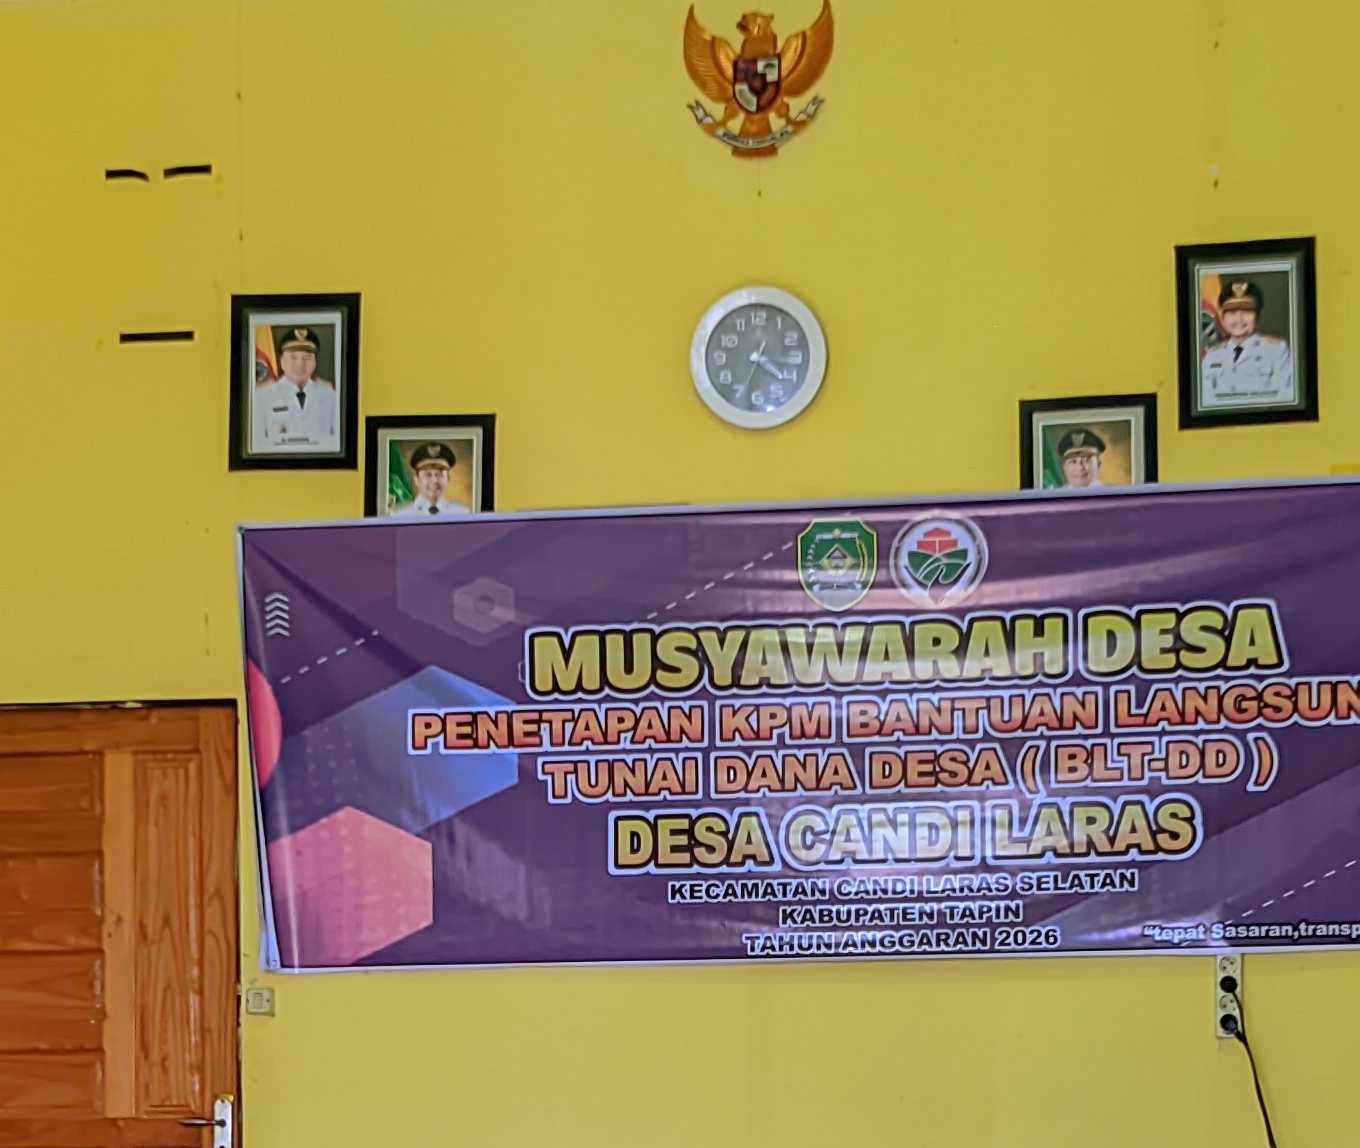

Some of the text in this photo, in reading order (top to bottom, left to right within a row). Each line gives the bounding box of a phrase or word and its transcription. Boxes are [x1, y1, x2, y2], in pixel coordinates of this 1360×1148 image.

[736, 319, 745, 332] 11
[751, 310, 766, 325] 12
[721, 335, 738, 348] 10
[785, 333, 798, 346] 2
[719, 370, 732, 384] 8
[733, 384, 745, 398] 7
[751, 391, 764, 405] 6
[530, 605, 1282, 695] MUSYAWARAH DESA
[411, 703, 704, 750] PENETAPAN
[719, 701, 831, 741] KPM
[846, 692, 1098, 738] BANTUAN
[543, 757, 698, 798] TUNAI
[714, 752, 855, 795] DANA
[869, 746, 1007, 789] DESA
[1056, 740, 1241, 783] BLT-DD
[613, 799, 1197, 869] DESA CANDI LARAS
[668, 870, 1138, 903] KECAMATAN CANDI LARAS SELATAN
[779, 901, 1023, 927] KABUPATEN TAPIN
[743, 927, 1060, 955] TAHUN ANGGARAN 2026
